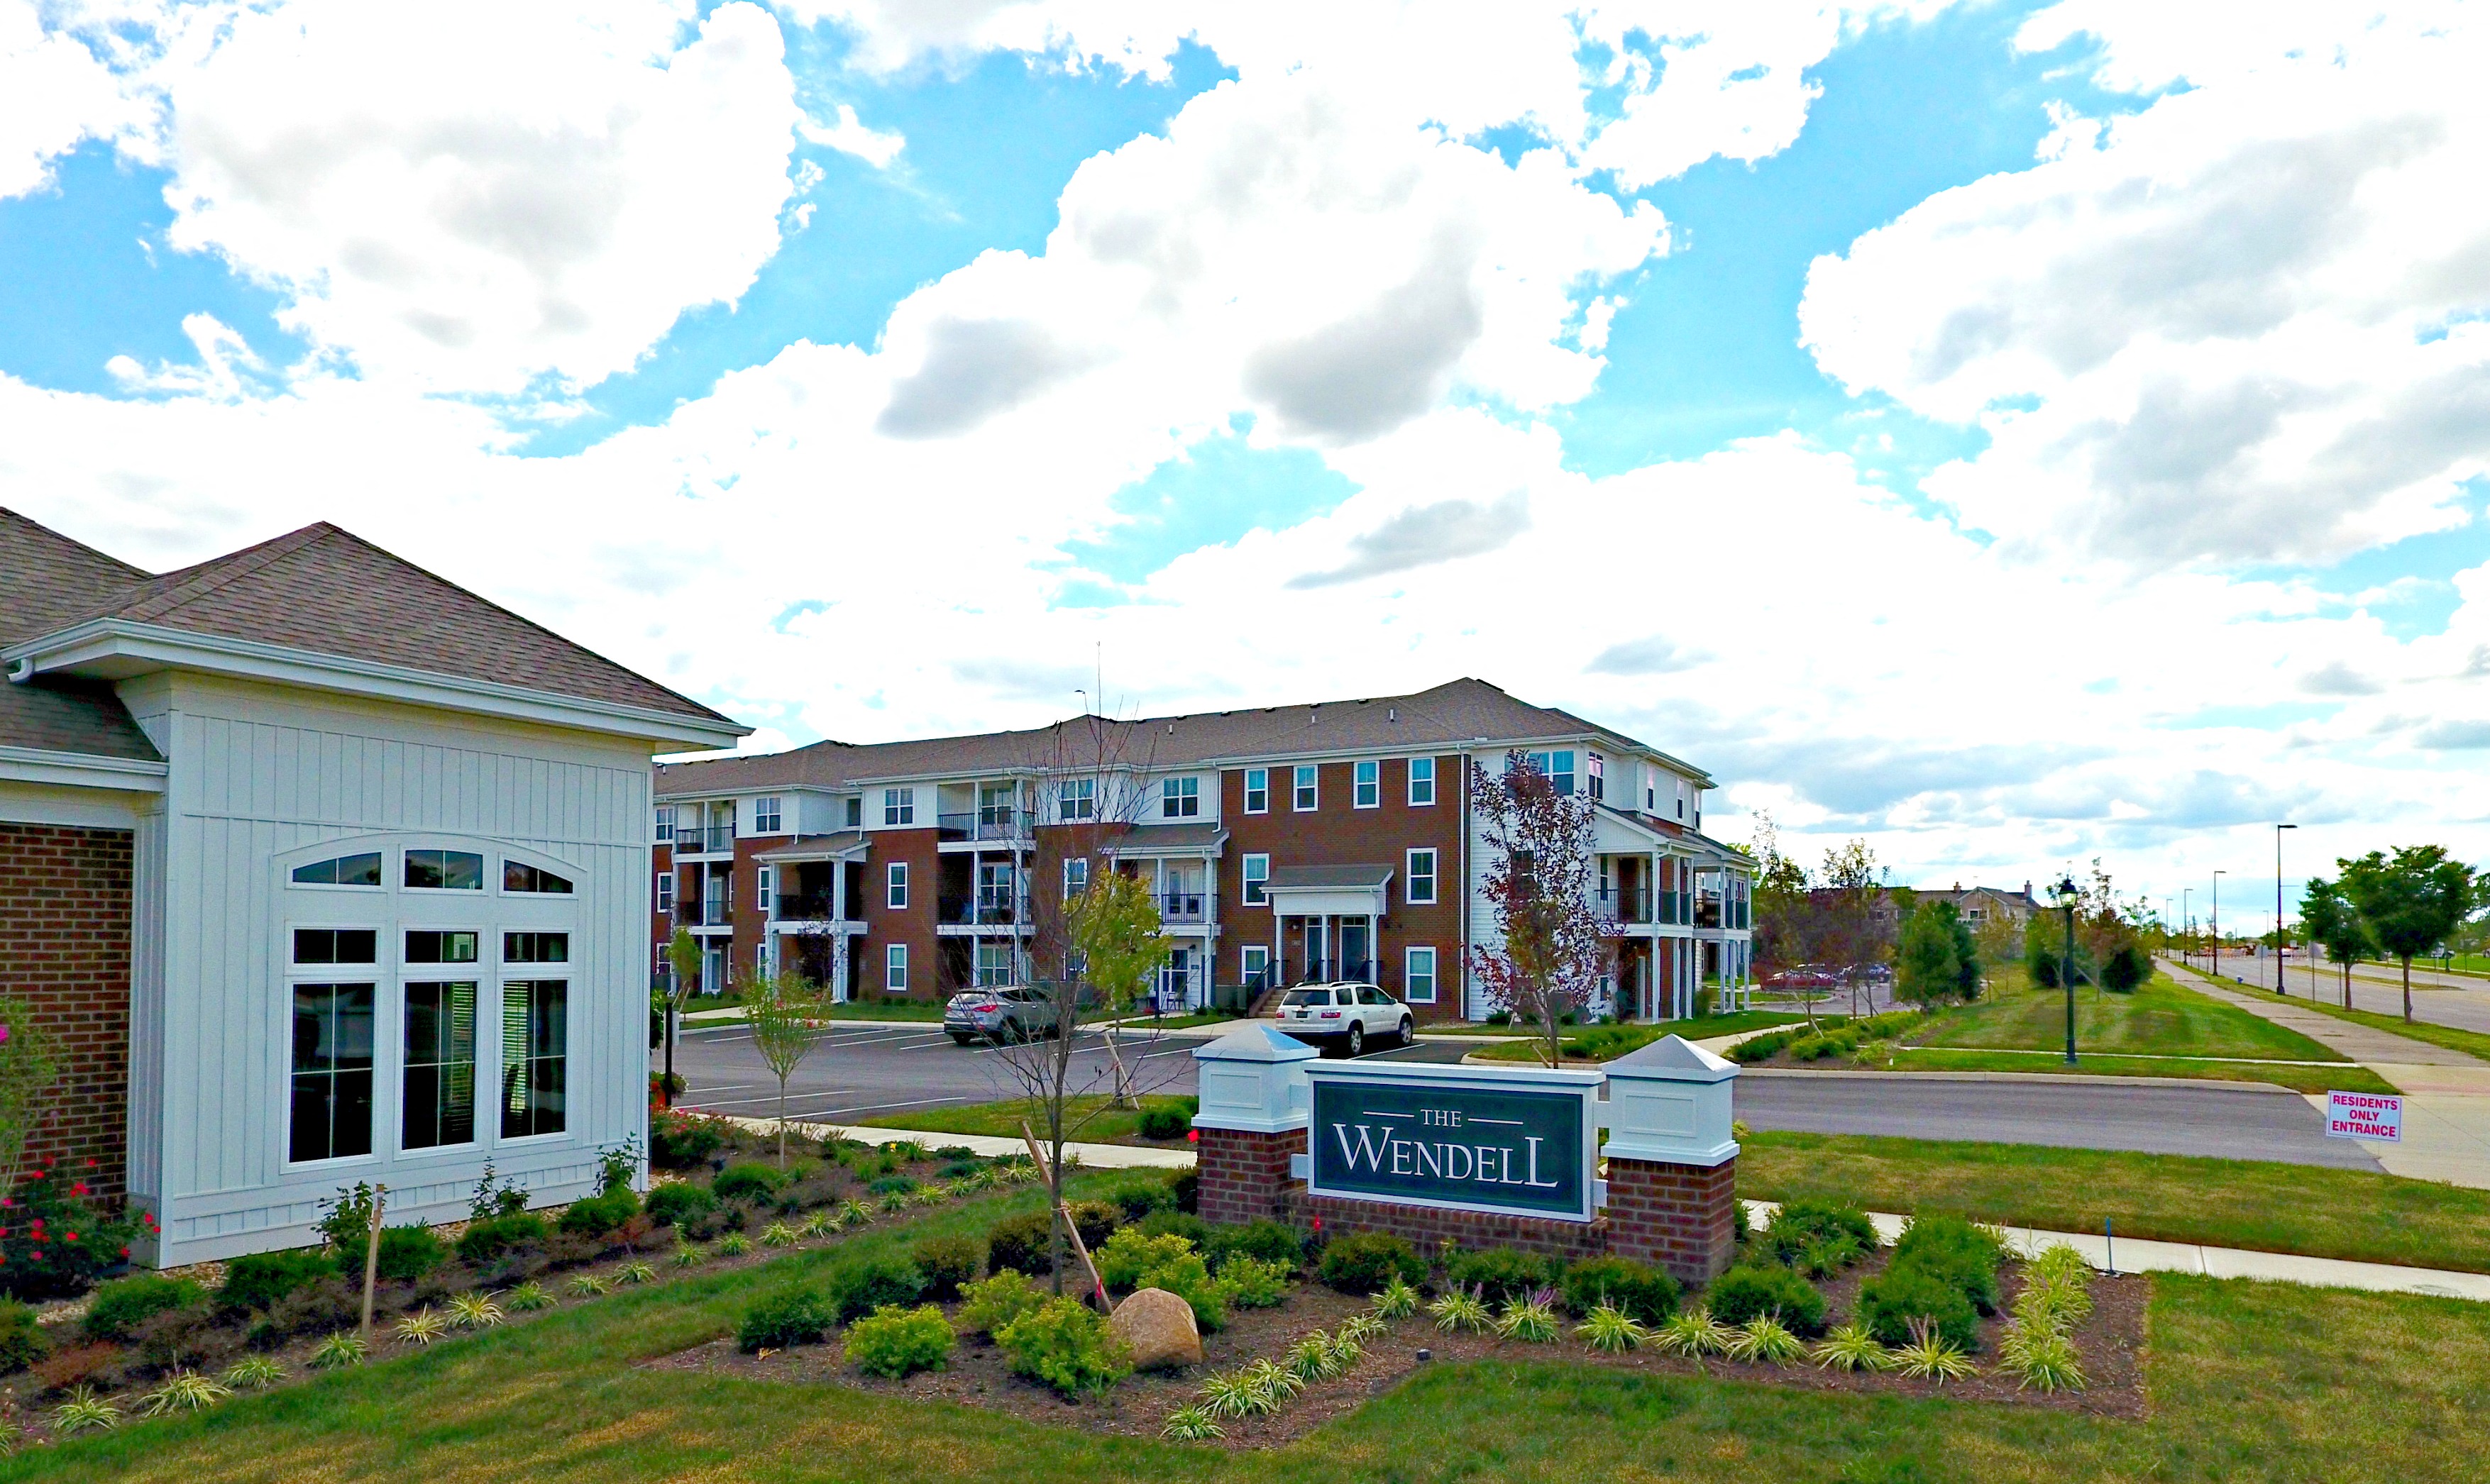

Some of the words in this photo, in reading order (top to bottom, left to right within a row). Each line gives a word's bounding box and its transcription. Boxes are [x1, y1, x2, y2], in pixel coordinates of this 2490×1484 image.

[2333, 1095, 2398, 1110] RESIDENTS
[1420, 1109, 1462, 1128] THE
[2349, 1109, 2379, 1122] ONLY
[2332, 1120, 2396, 1137] ENTRANCE
[1332, 1123, 1558, 1187] WENDELL
